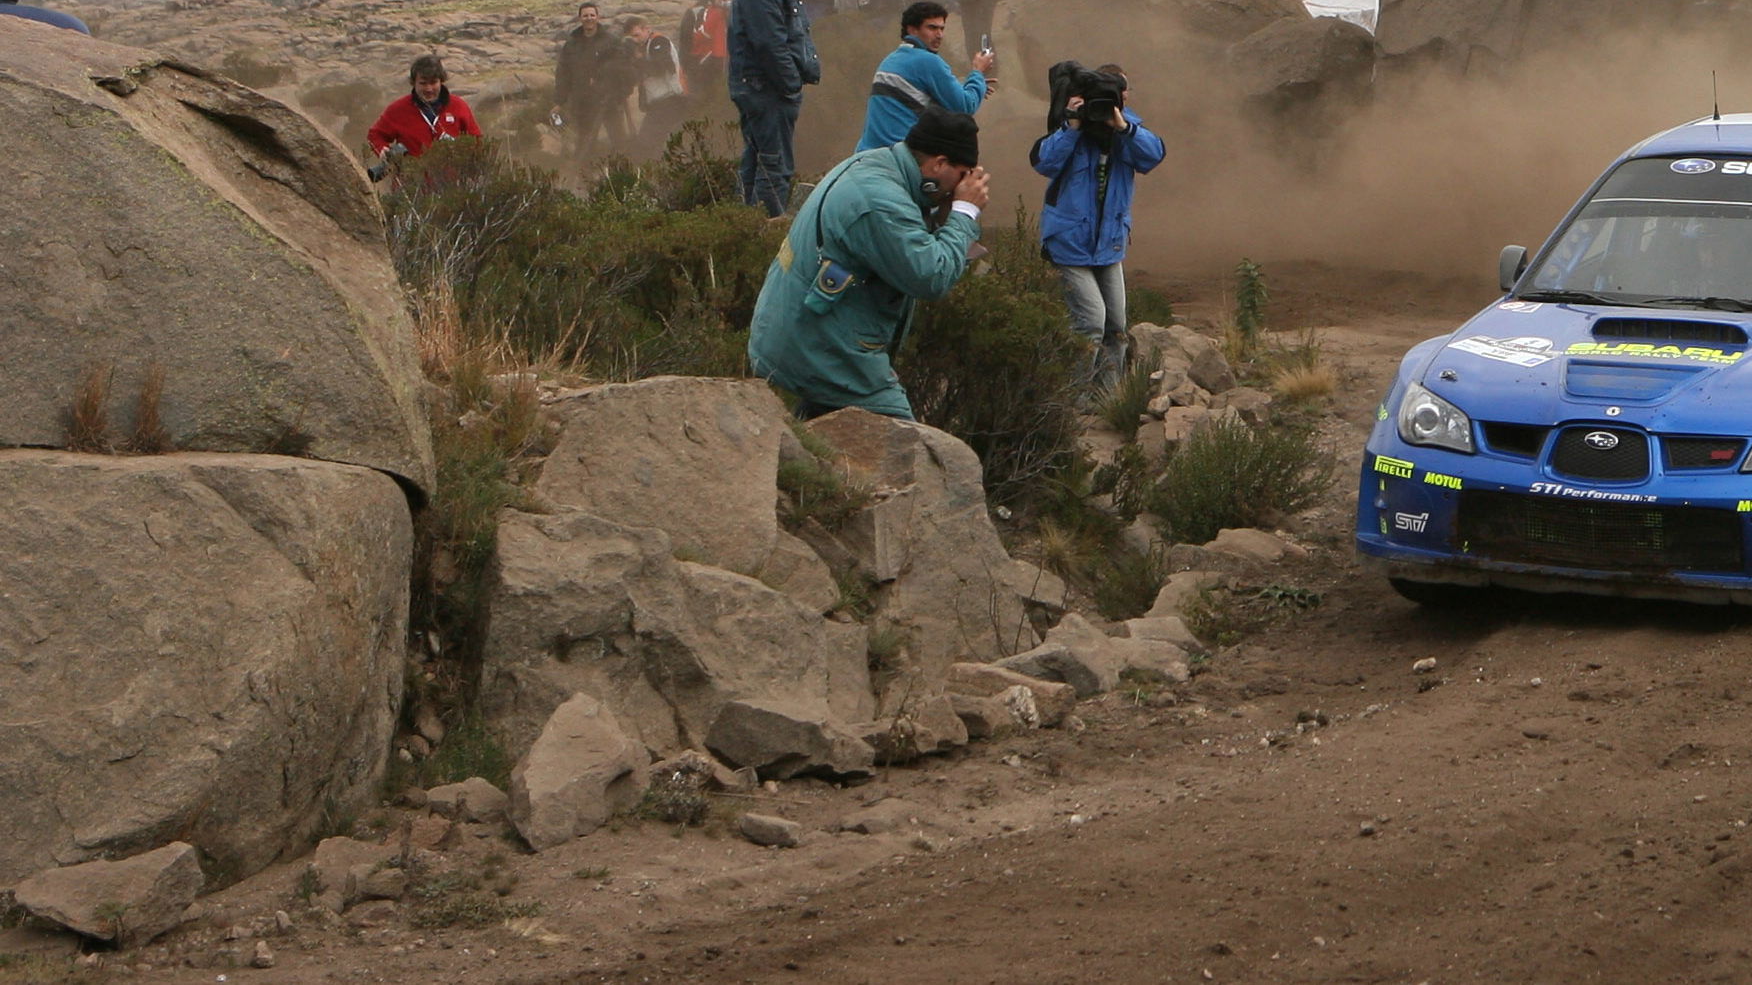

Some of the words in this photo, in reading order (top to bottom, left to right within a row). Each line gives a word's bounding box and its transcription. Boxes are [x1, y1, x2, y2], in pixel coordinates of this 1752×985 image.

[1567, 342, 1744, 360] SUBARU
[1374, 455, 1415, 479] PIRELLI
[1424, 471, 1463, 490] MOTUL
[1529, 482, 1562, 494] STI
